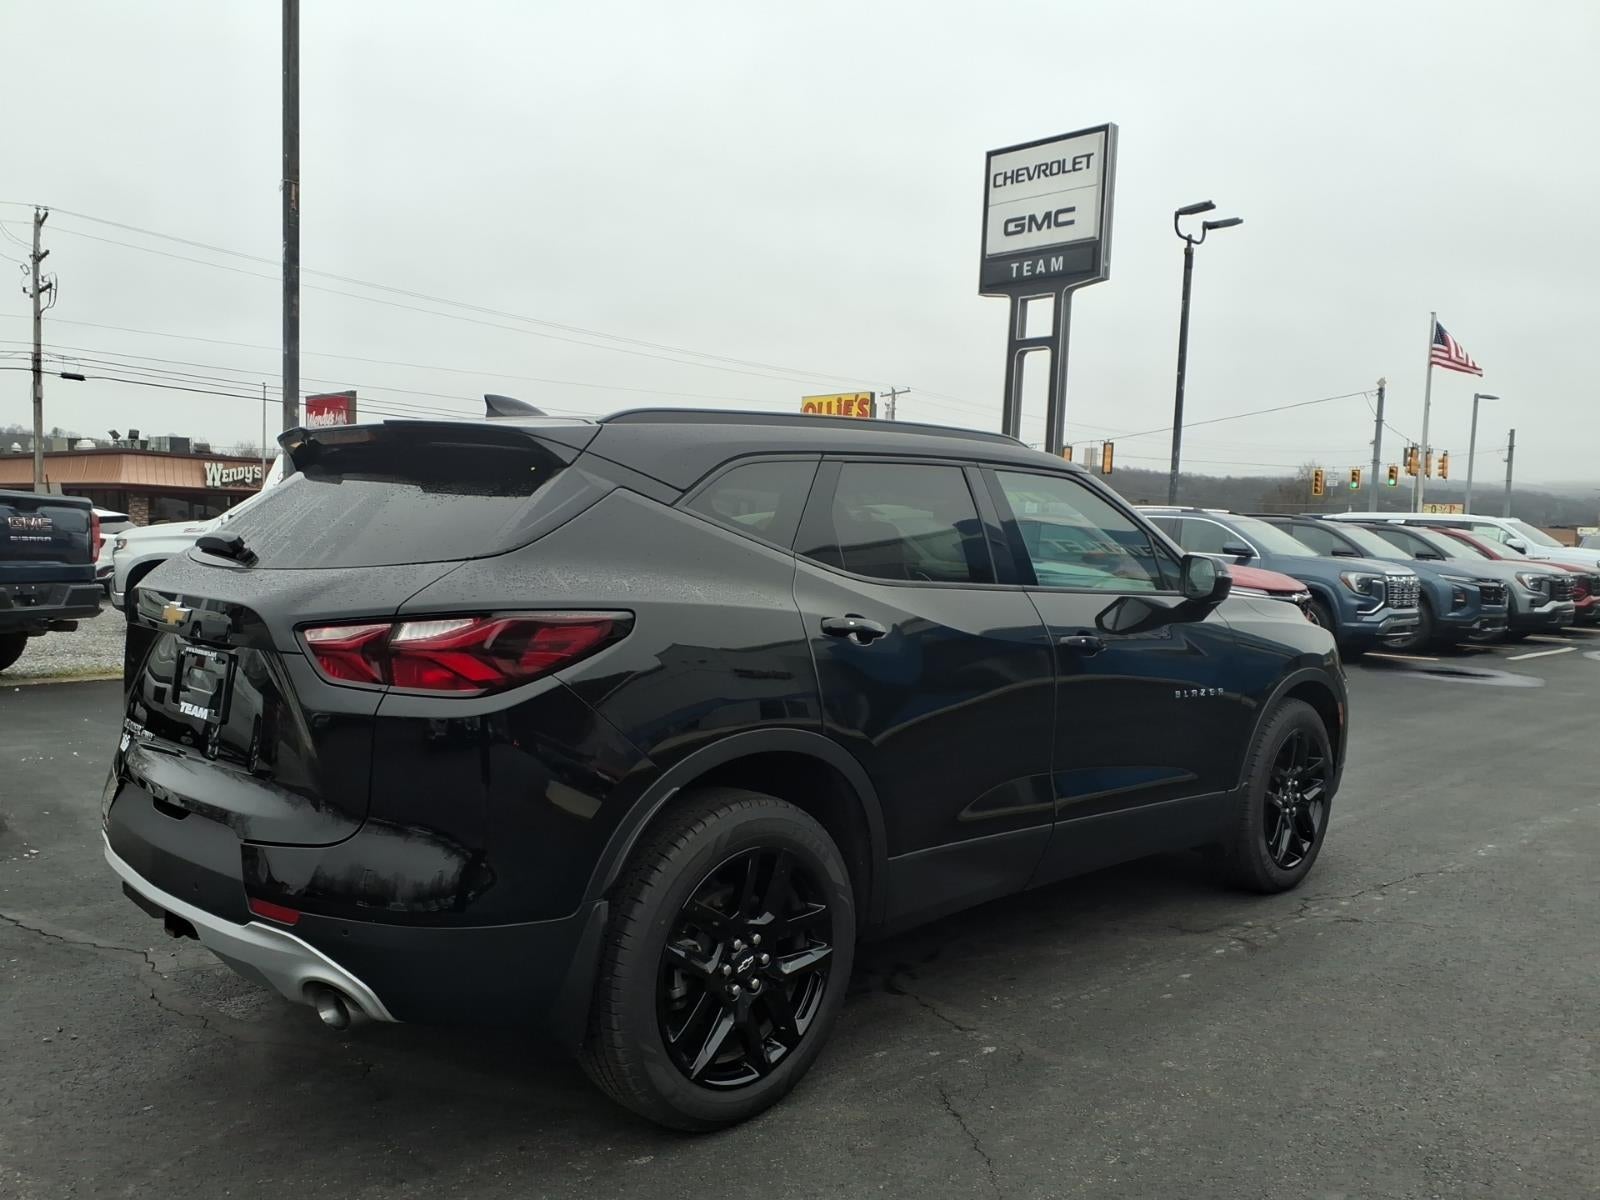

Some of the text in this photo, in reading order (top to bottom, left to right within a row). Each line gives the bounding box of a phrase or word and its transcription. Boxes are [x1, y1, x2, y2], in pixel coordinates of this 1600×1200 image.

[993, 152, 1094, 189] CHEVROLET
[1003, 206, 1076, 237] GMC
[1010, 255, 1064, 278] TEAM
[204, 462, 262, 487] Wendy's
[8, 516, 53, 530] GMC
[1175, 687, 1224, 699] BLAZER
[180, 701, 209, 720] TEAM
